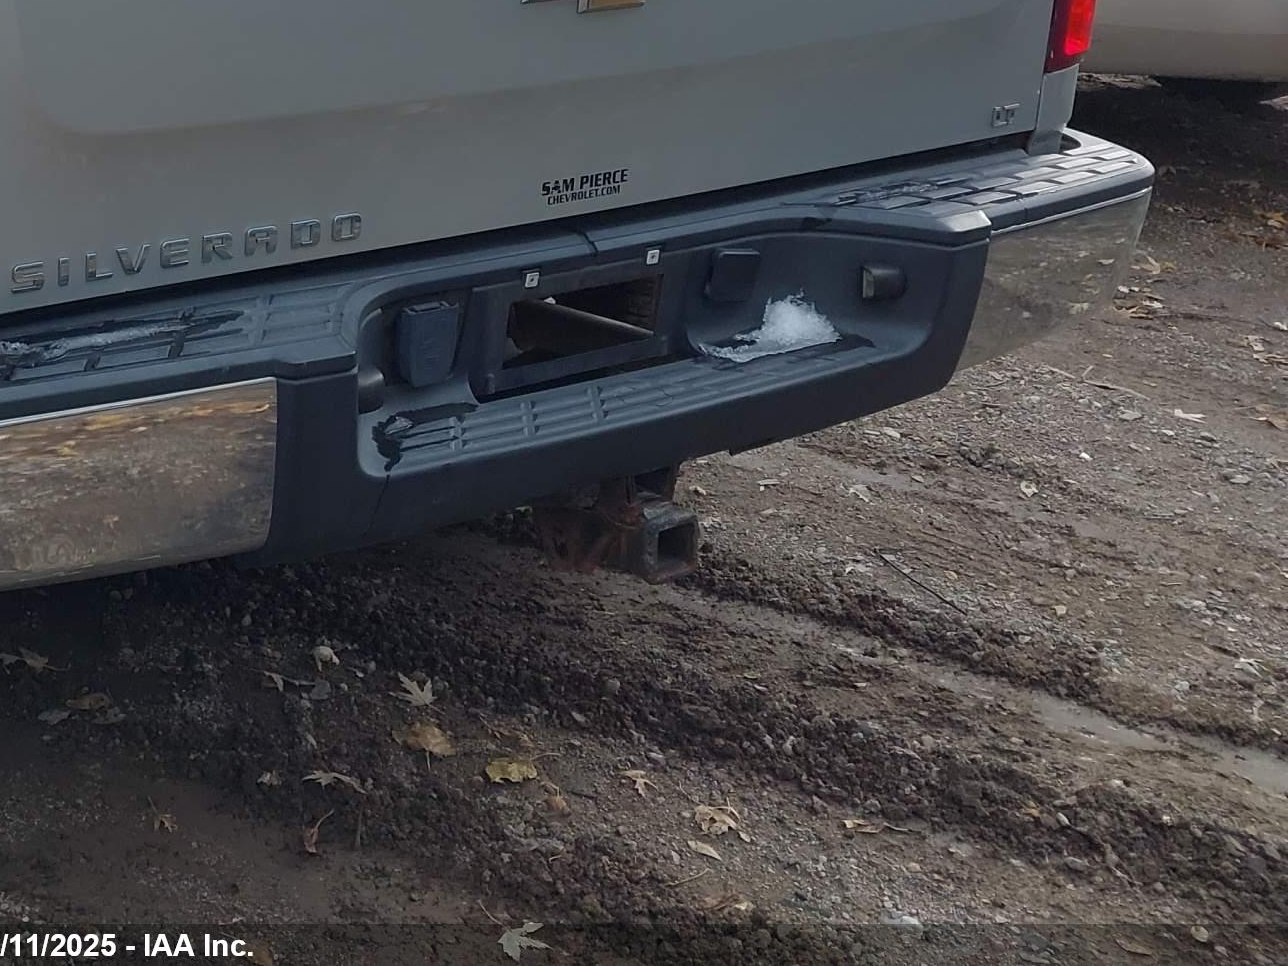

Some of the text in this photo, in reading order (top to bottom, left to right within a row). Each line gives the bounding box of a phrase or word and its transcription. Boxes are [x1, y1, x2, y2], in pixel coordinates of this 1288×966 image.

[542, 169, 629, 196] SAM PIERCE
[548, 185, 620, 205] CHEVROLET.COM
[11, 212, 362, 294] SILVERADO
